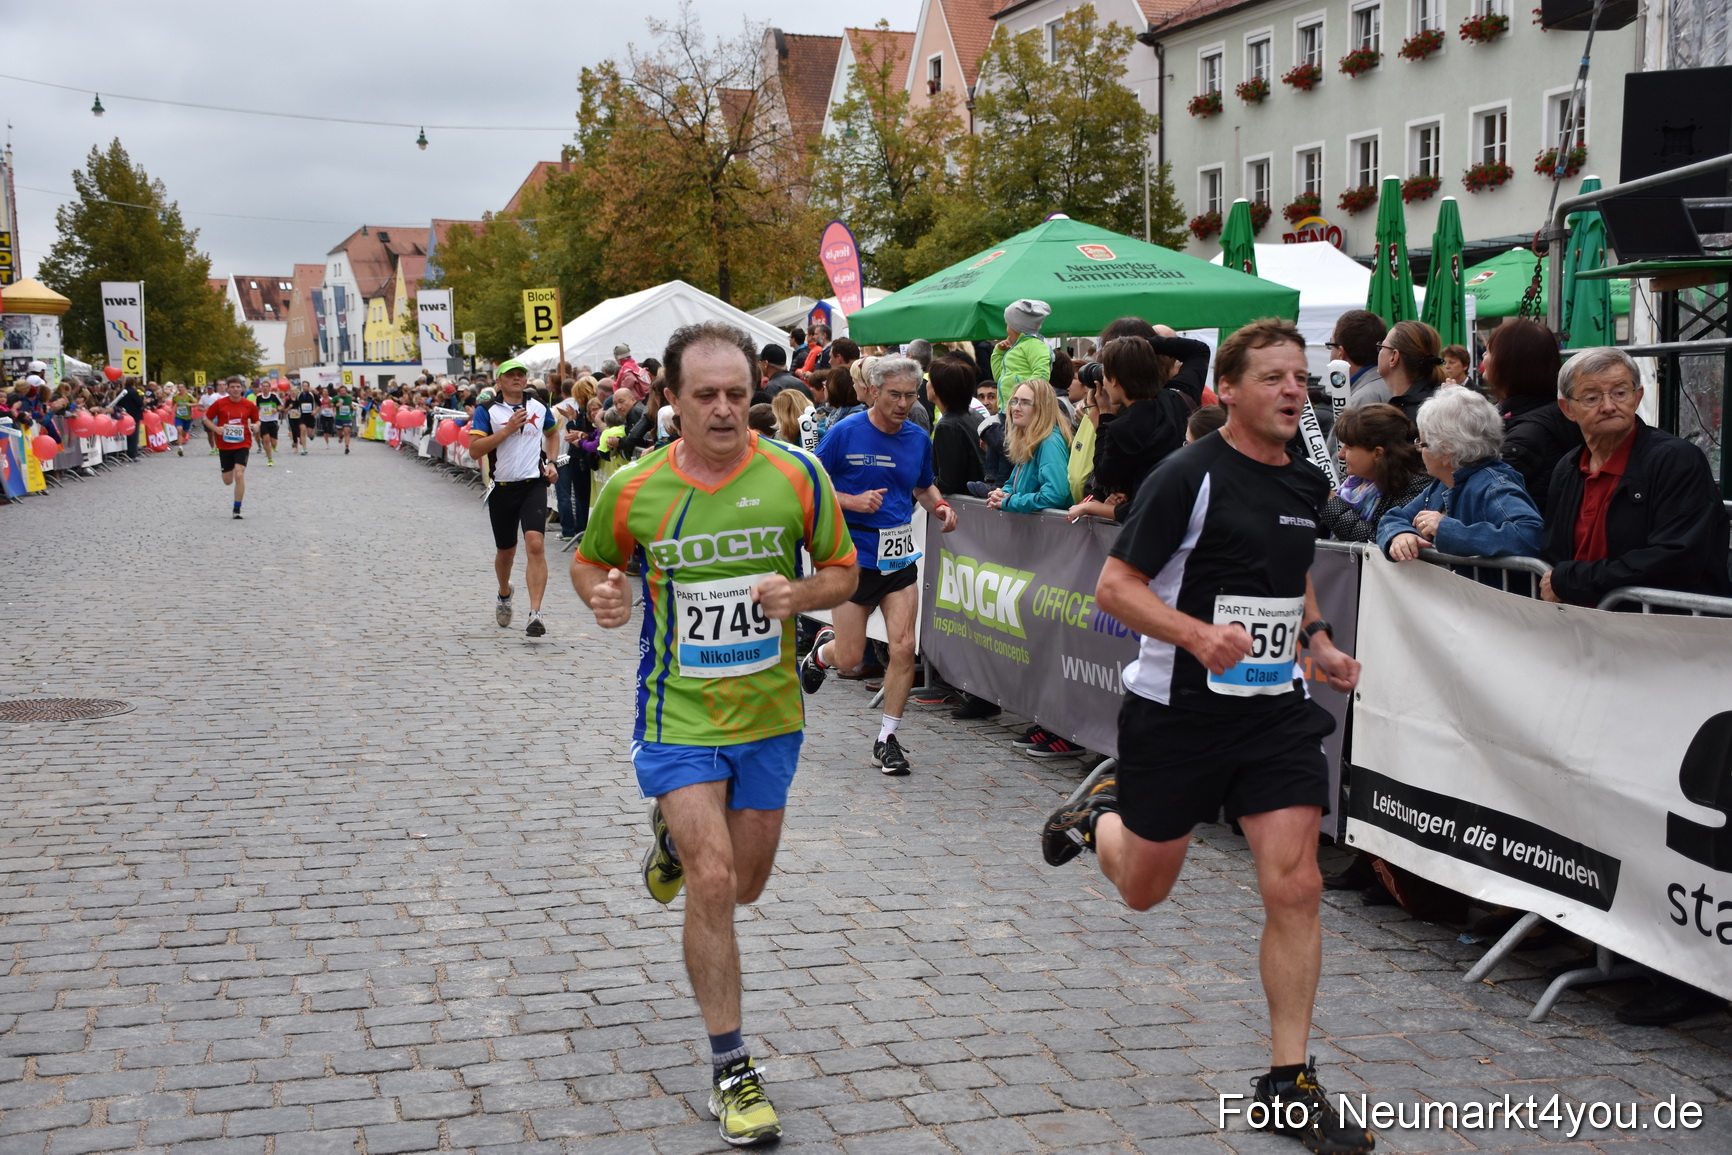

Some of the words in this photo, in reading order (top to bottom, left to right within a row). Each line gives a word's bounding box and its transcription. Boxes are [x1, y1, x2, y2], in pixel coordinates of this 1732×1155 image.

[1054, 269, 1186, 283] Lammsbräu
[1066, 262, 1158, 273] Neumarkter
[528, 291, 556, 302] Block
[534, 306, 553, 332] B
[127, 356, 137, 370] C
[197, 375, 204, 383] D
[345, 374, 351, 383] D
[1302, 398, 1319, 431] MW
[1333, 397, 1346, 419] BM
[1308, 434, 1338, 491] Laufspo
[650, 529, 783, 569] BOCK
[884, 535, 914, 557] 2518
[676, 590, 708, 601] PARTL
[939, 555, 1028, 630] BOCK
[1032, 584, 1096, 629] OFFICE
[1217, 604, 1255, 617] PARTL
[687, 601, 771, 641] 2749
[933, 611, 967, 637] inspired
[973, 631, 993, 651] smart
[994, 639, 1030, 666] concepts
[1230, 620, 1297, 659] 591
[700, 647, 760, 665] Nikolaus
[1245, 667, 1279, 683] Claus
[1373, 790, 1457, 843] Leistungen,
[1463, 824, 1497, 851] die
[1502, 837, 1600, 890] verbinden
